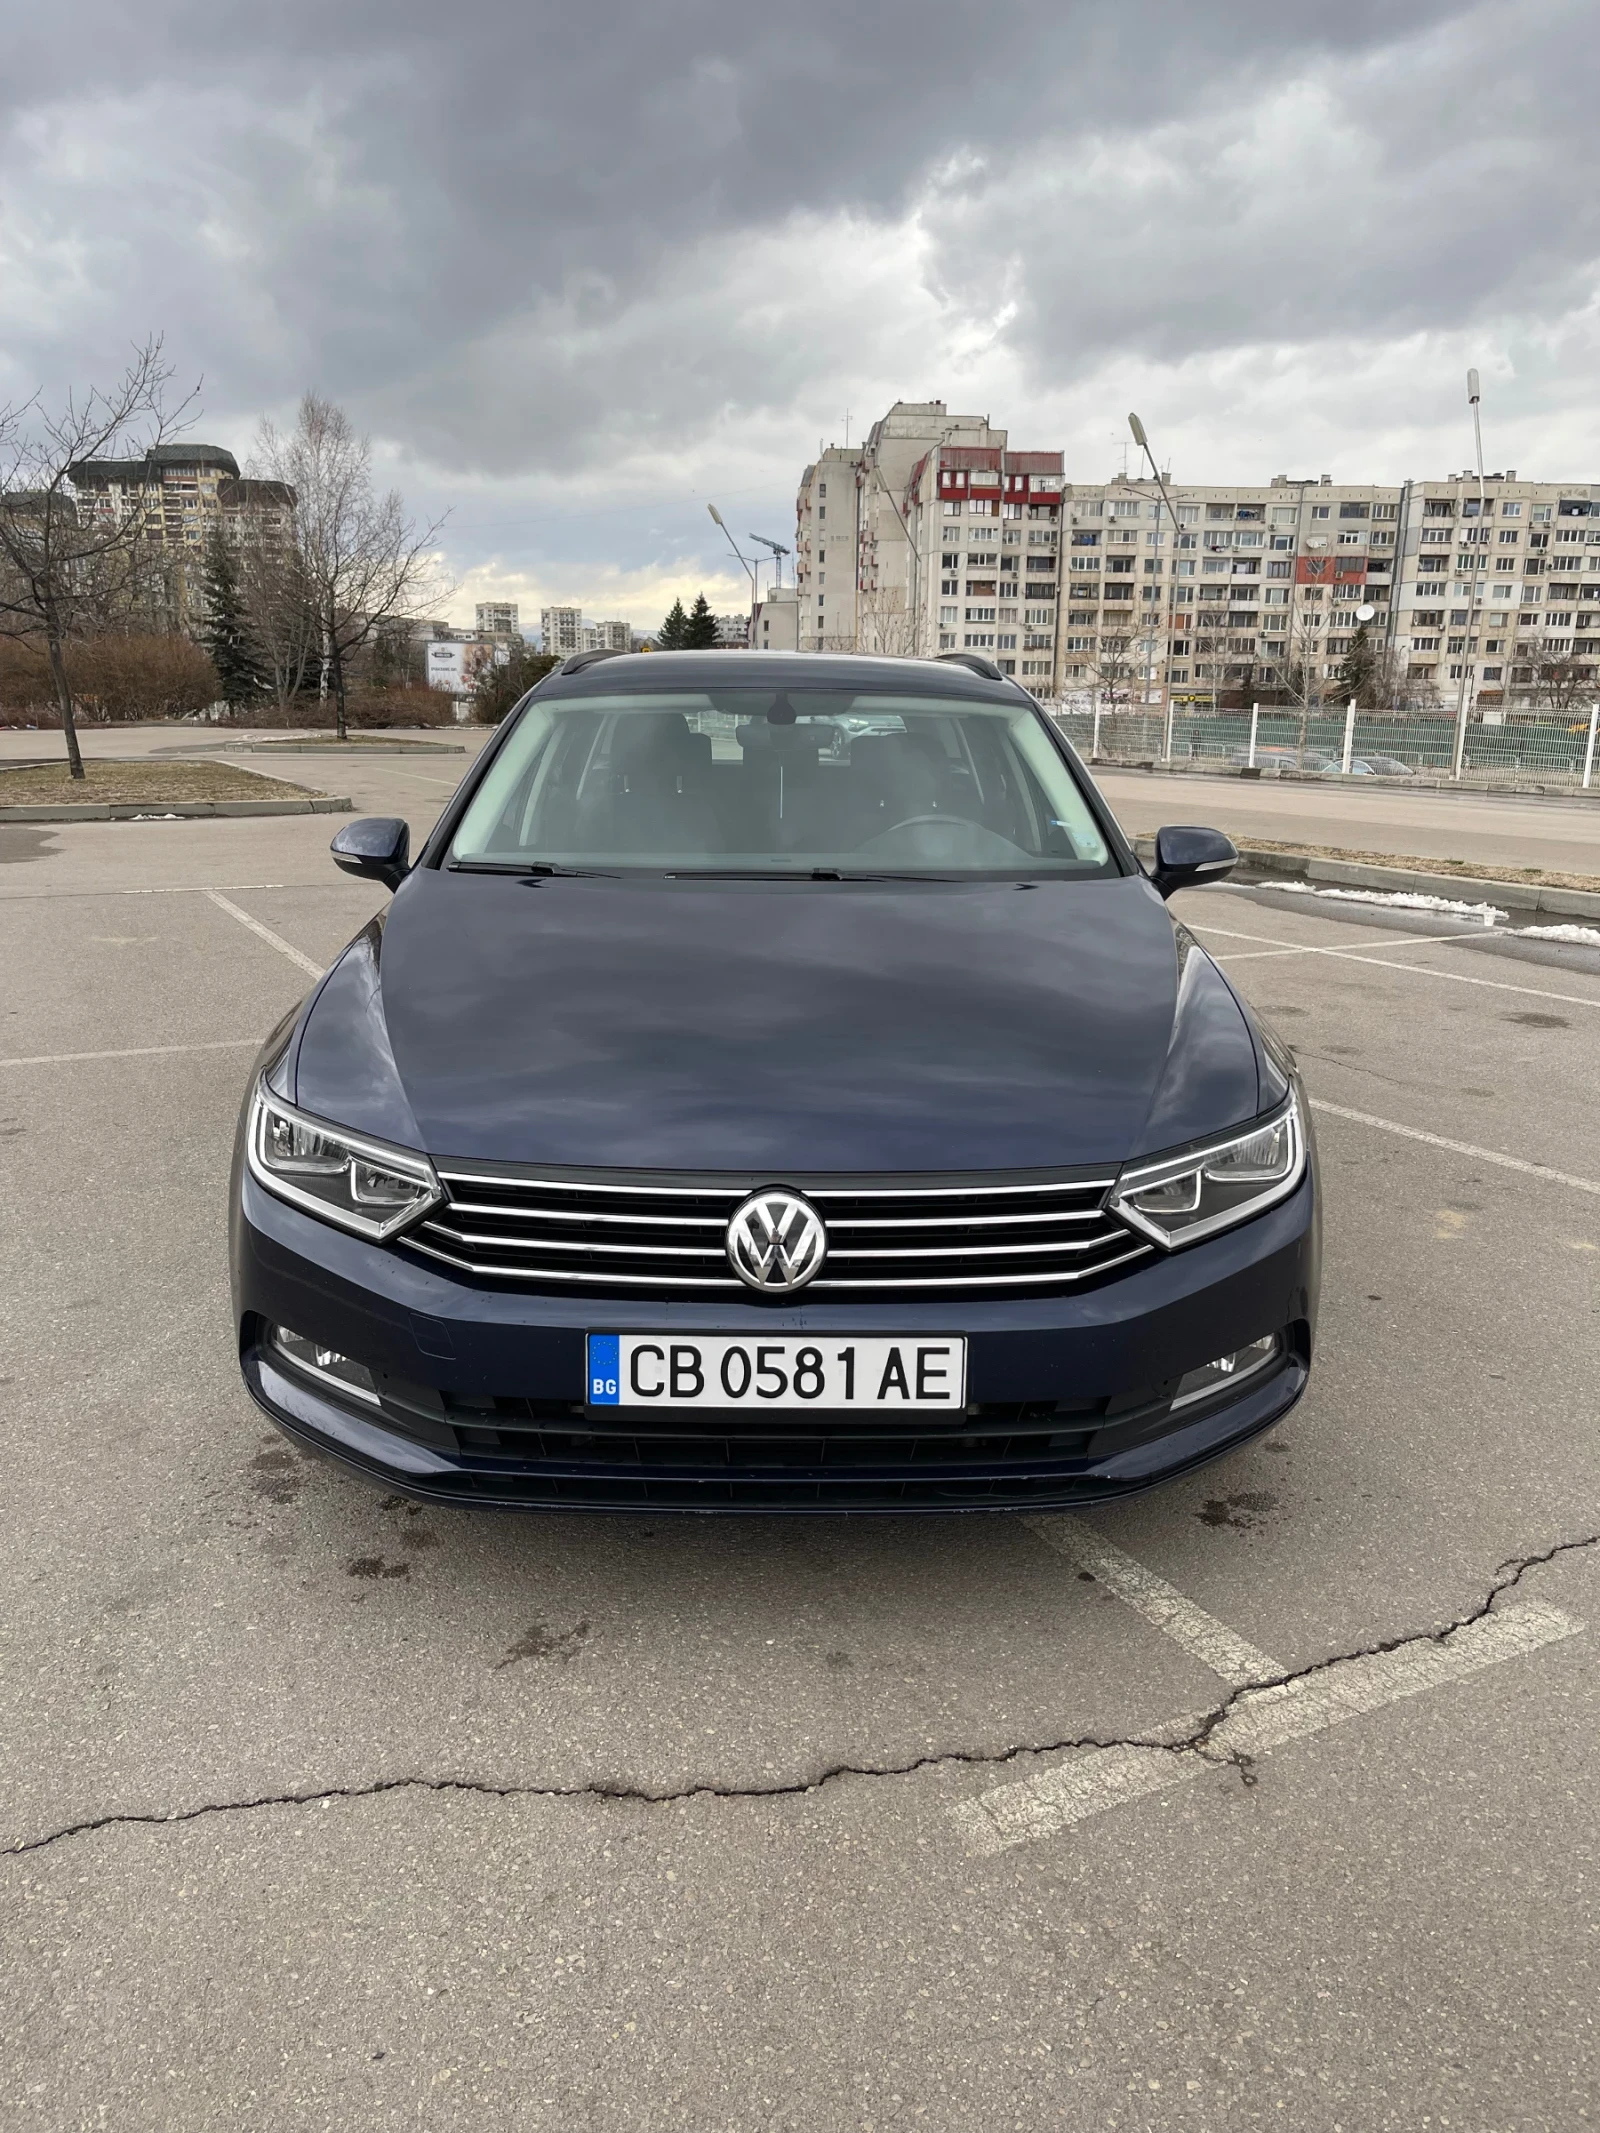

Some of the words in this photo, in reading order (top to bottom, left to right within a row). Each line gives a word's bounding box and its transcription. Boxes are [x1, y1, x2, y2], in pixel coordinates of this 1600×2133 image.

[733, 1199, 820, 1287] VW
[592, 1379, 617, 1395] BG
[629, 1343, 705, 1398] CB
[720, 1345, 855, 1400] 0581
[876, 1346, 951, 1400] AE
